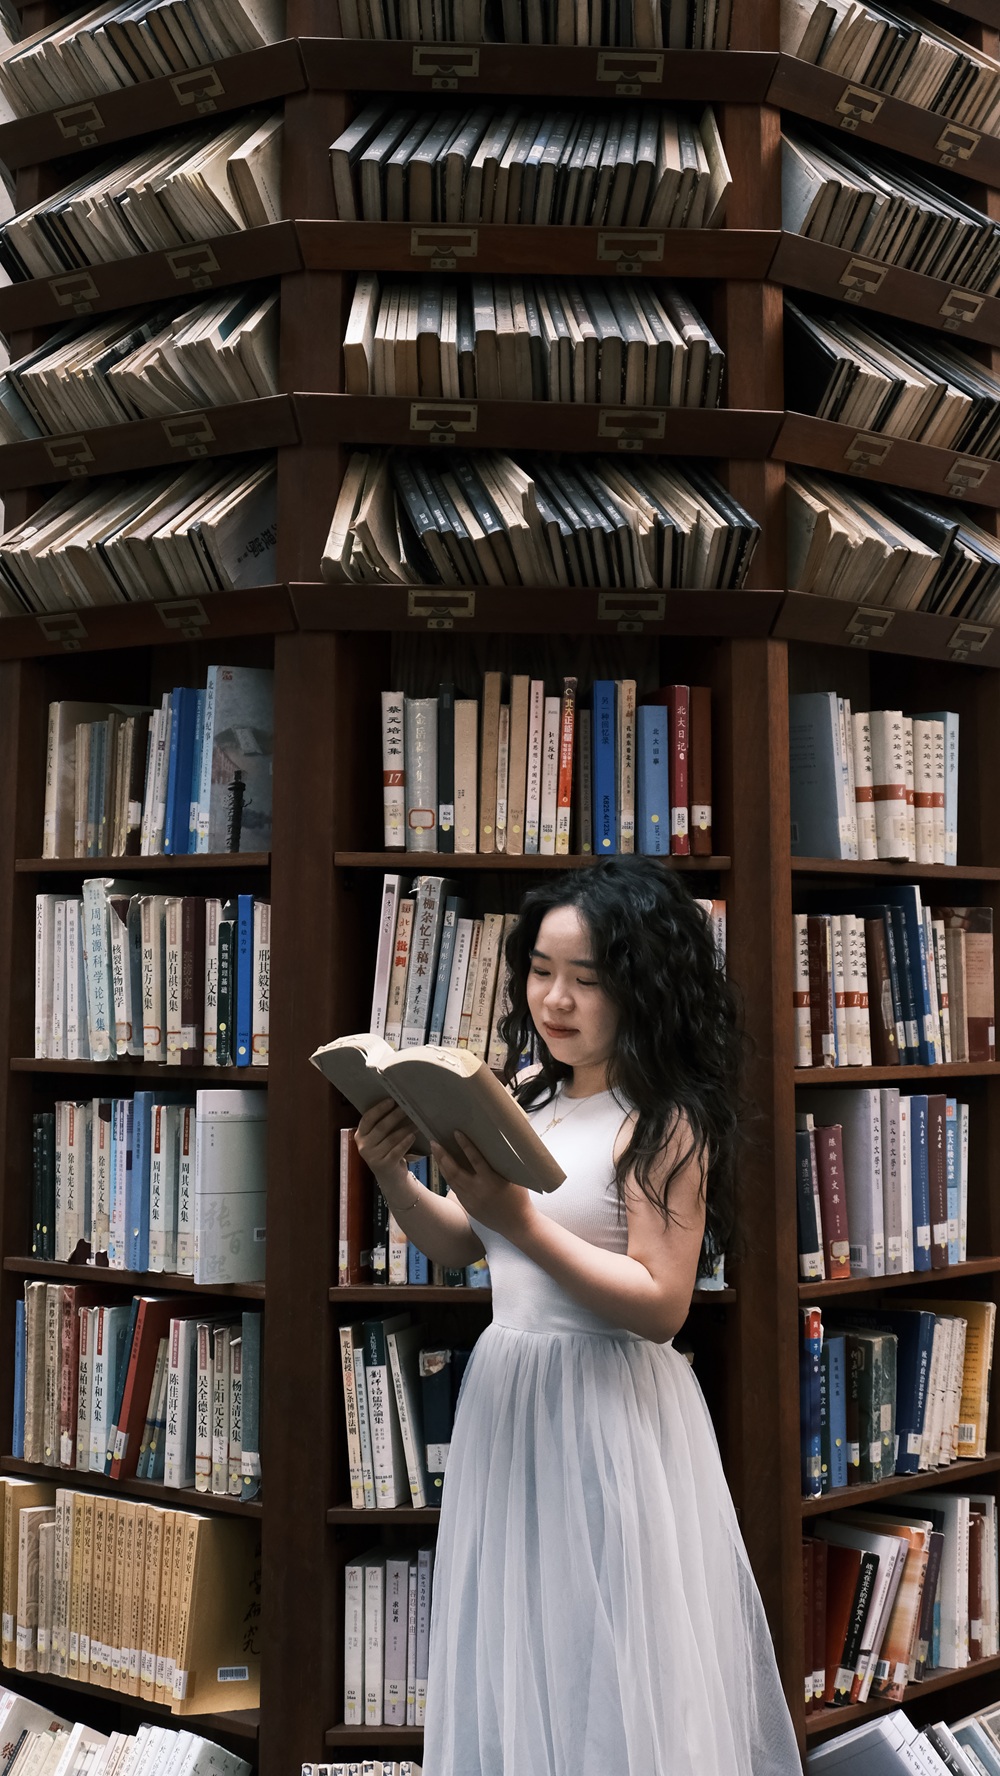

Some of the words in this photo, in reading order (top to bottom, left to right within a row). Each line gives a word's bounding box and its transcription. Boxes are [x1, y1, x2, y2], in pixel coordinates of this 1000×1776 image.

[386, 704, 402, 755] 蔡元培全集
[600, 695, 610, 745] 另一种回忆录
[652, 727, 660, 765] 北大旧事
[676, 705, 687, 751] 北大日记
[387, 772, 402, 785] 17
[529, 729, 539, 801] 严复思想与中国现代化
[415, 884, 436, 977] 牛棚杂忆手稿本
[90, 907, 106, 1031] 周培源科学论文集
[112, 943, 124, 1008] 核裂变物理学
[143, 948, 153, 1010] 刘元方文集
[168, 950, 178, 1012] 唐有祺文集
[206, 957, 217, 1007] 王仁文集
[258, 950, 270, 1012] 邢其毅文集
[67, 1152, 75, 1210] 徐光宪文集
[97, 1155, 105, 1214] 徐光宪文集
[152, 1160, 161, 1220] 周其凤文集
[180, 1162, 190, 1222] 周其凤文集
[828, 1137, 840, 1204] 陈翰笙文集
[78, 1361, 88, 1421] 赵柏林文集
[94, 1362, 103, 1422] 翟中和文集
[168, 1374, 179, 1436] 陈佳洱文集
[197, 1375, 208, 1438] 吴全德文集
[213, 1379, 224, 1438] 王阳元文集
[231, 1379, 242, 1443] 杨芙清文集
[855, 1563, 874, 1622] 战斗在北大的共产党人
